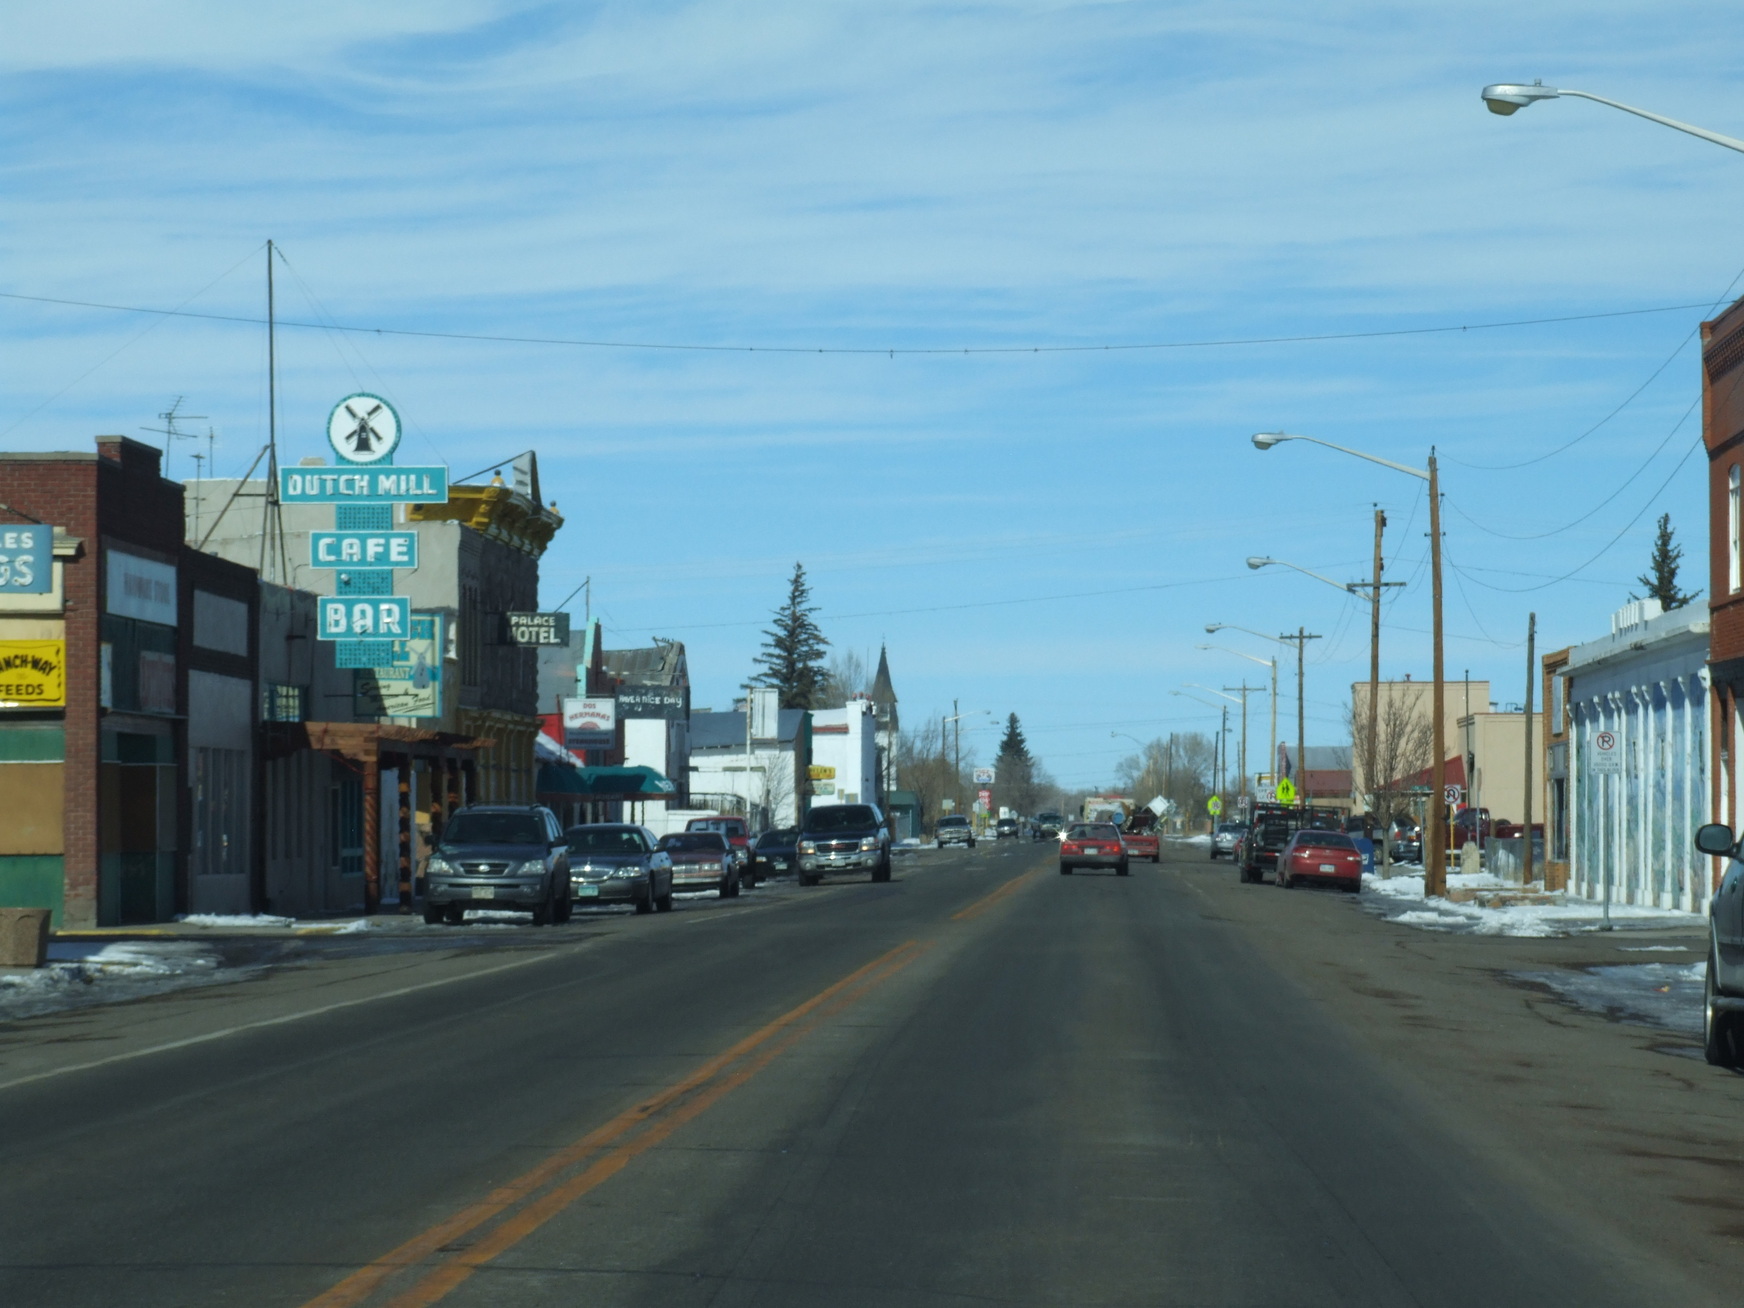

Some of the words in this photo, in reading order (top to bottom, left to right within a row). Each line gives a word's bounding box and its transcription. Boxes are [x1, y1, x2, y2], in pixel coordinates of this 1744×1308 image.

[288, 474, 369, 495] DUTCH
[378, 474, 437, 496] MILL
[0, 532, 34, 549] ES
[318, 538, 409, 562] CAFE
[326, 603, 401, 633] BAR
[511, 616, 555, 626] PALACE
[569, 712, 610, 722] HERMANAS
